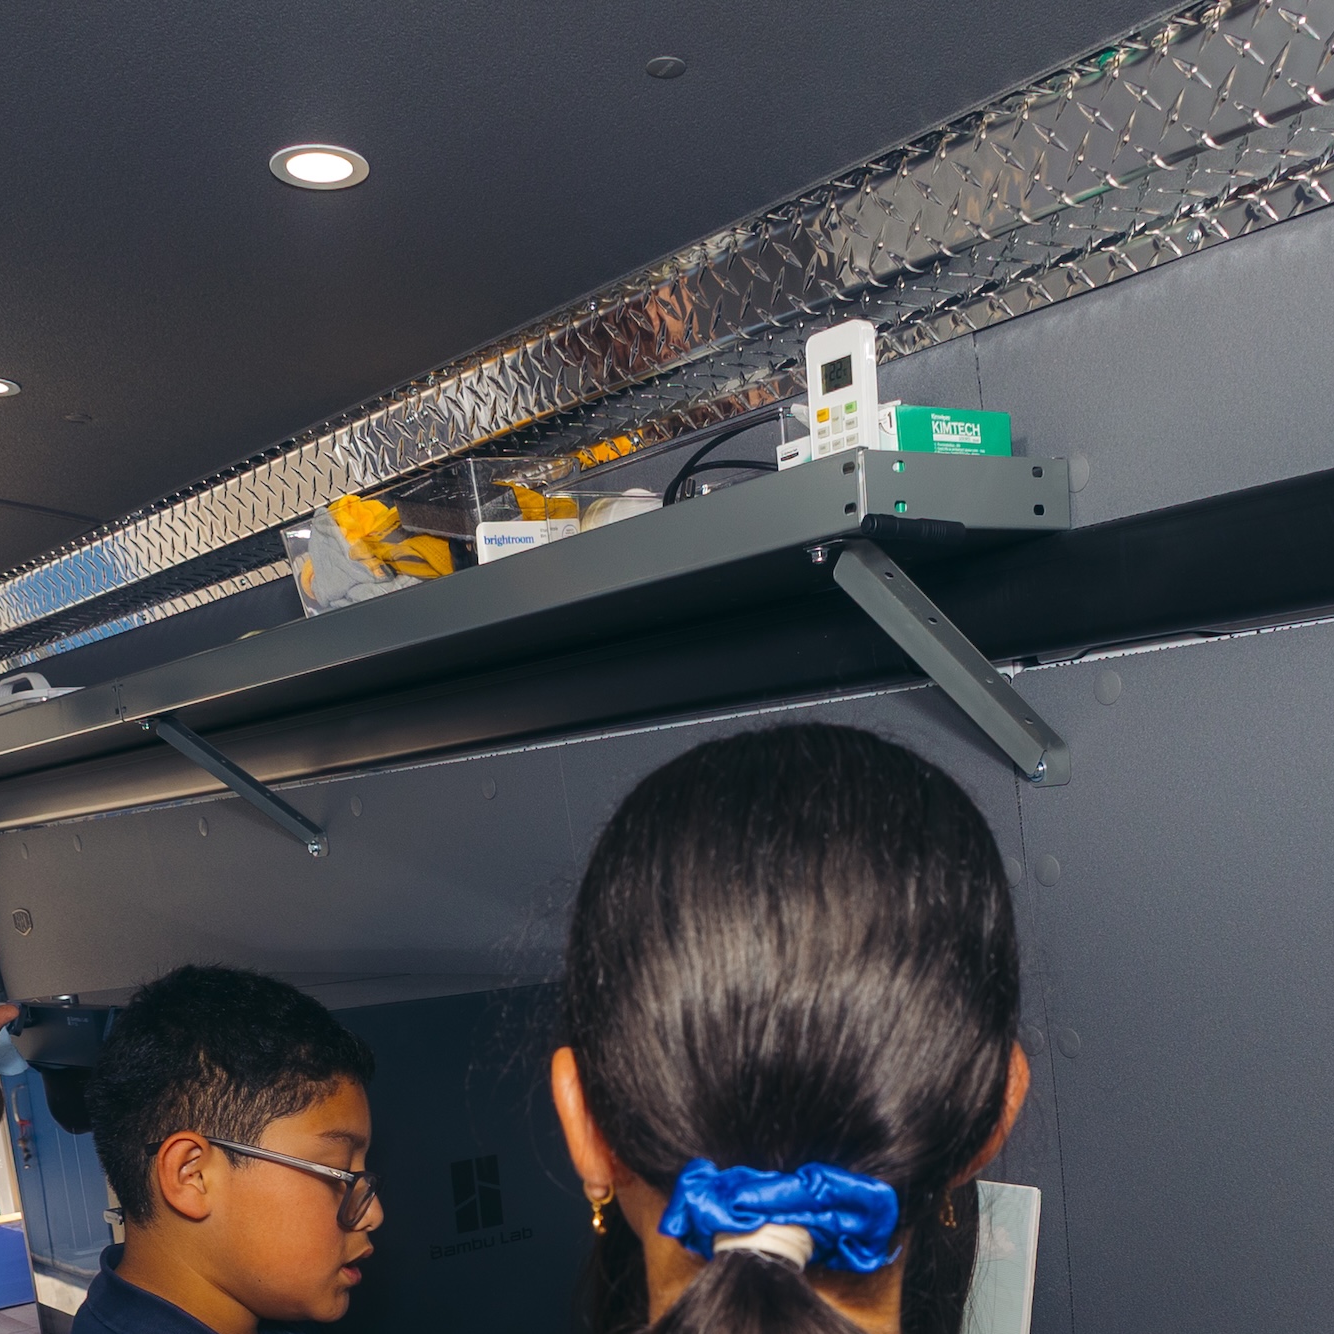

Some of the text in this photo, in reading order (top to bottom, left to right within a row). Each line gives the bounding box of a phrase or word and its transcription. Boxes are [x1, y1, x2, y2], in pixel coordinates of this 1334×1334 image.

[931, 421, 981, 436] KIMTECH
[483, 534, 535, 547] brightroom
[429, 1226, 534, 1260] Bambu Lab
